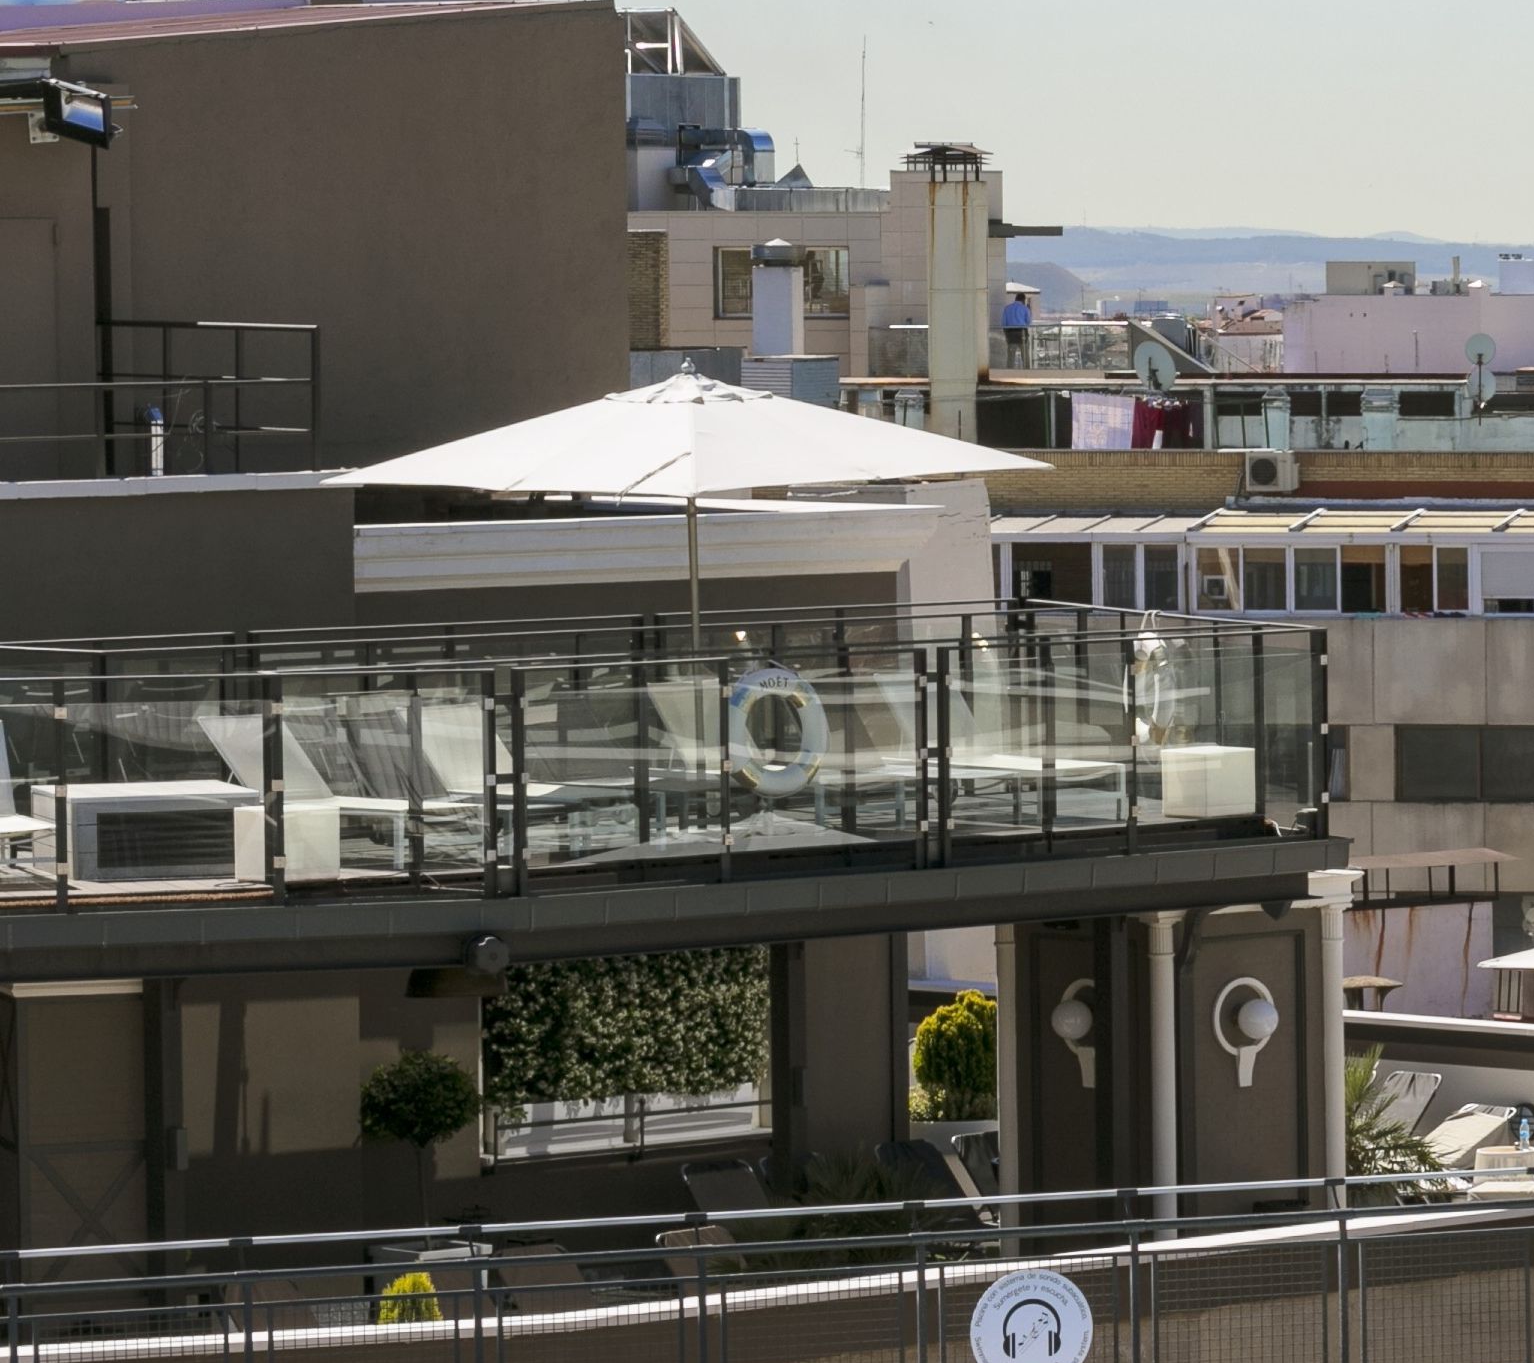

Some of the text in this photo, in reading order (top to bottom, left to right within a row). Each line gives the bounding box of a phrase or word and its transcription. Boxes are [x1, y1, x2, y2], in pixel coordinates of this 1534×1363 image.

[974, 1302, 989, 1327] Piscina
[987, 1289, 999, 1302] con
[998, 1274, 1025, 1290] sistema
[1027, 1272, 1036, 1280] de
[1039, 1274, 1061, 1285] sonido
[1033, 1284, 1038, 1293] y
